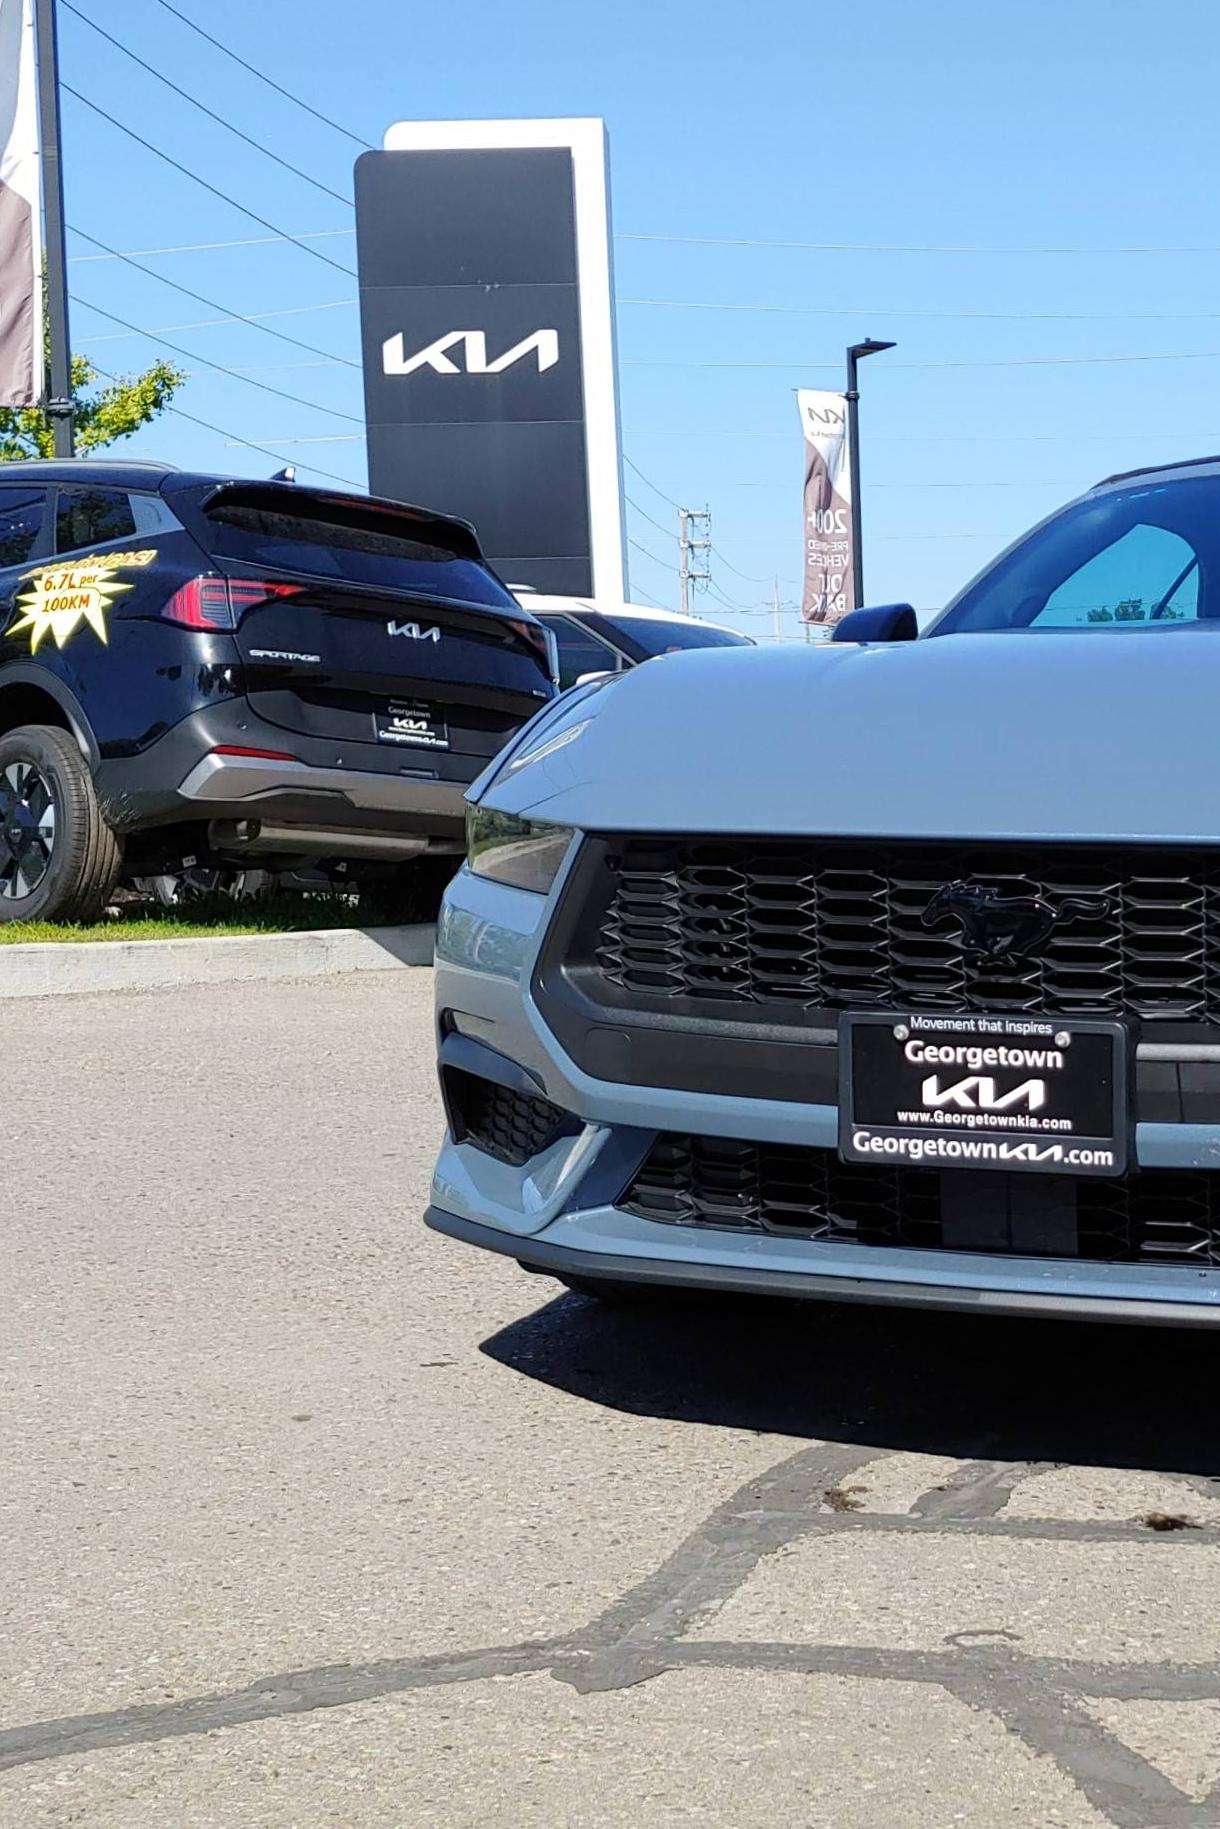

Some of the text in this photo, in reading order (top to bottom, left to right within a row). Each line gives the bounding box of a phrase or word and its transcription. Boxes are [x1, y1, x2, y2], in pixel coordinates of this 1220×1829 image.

[382, 329, 559, 375] KIA
[44, 573, 98, 591] 6.7L per
[42, 594, 90, 613] 100KM
[387, 620, 441, 643] KIA
[250, 649, 321, 662] SPORTAGE
[393, 717, 428, 730] KIA
[910, 1016, 1053, 1035] Movement that inspires
[904, 1040, 1063, 1070] Georgetown
[922, 1074, 1045, 1111] KIA
